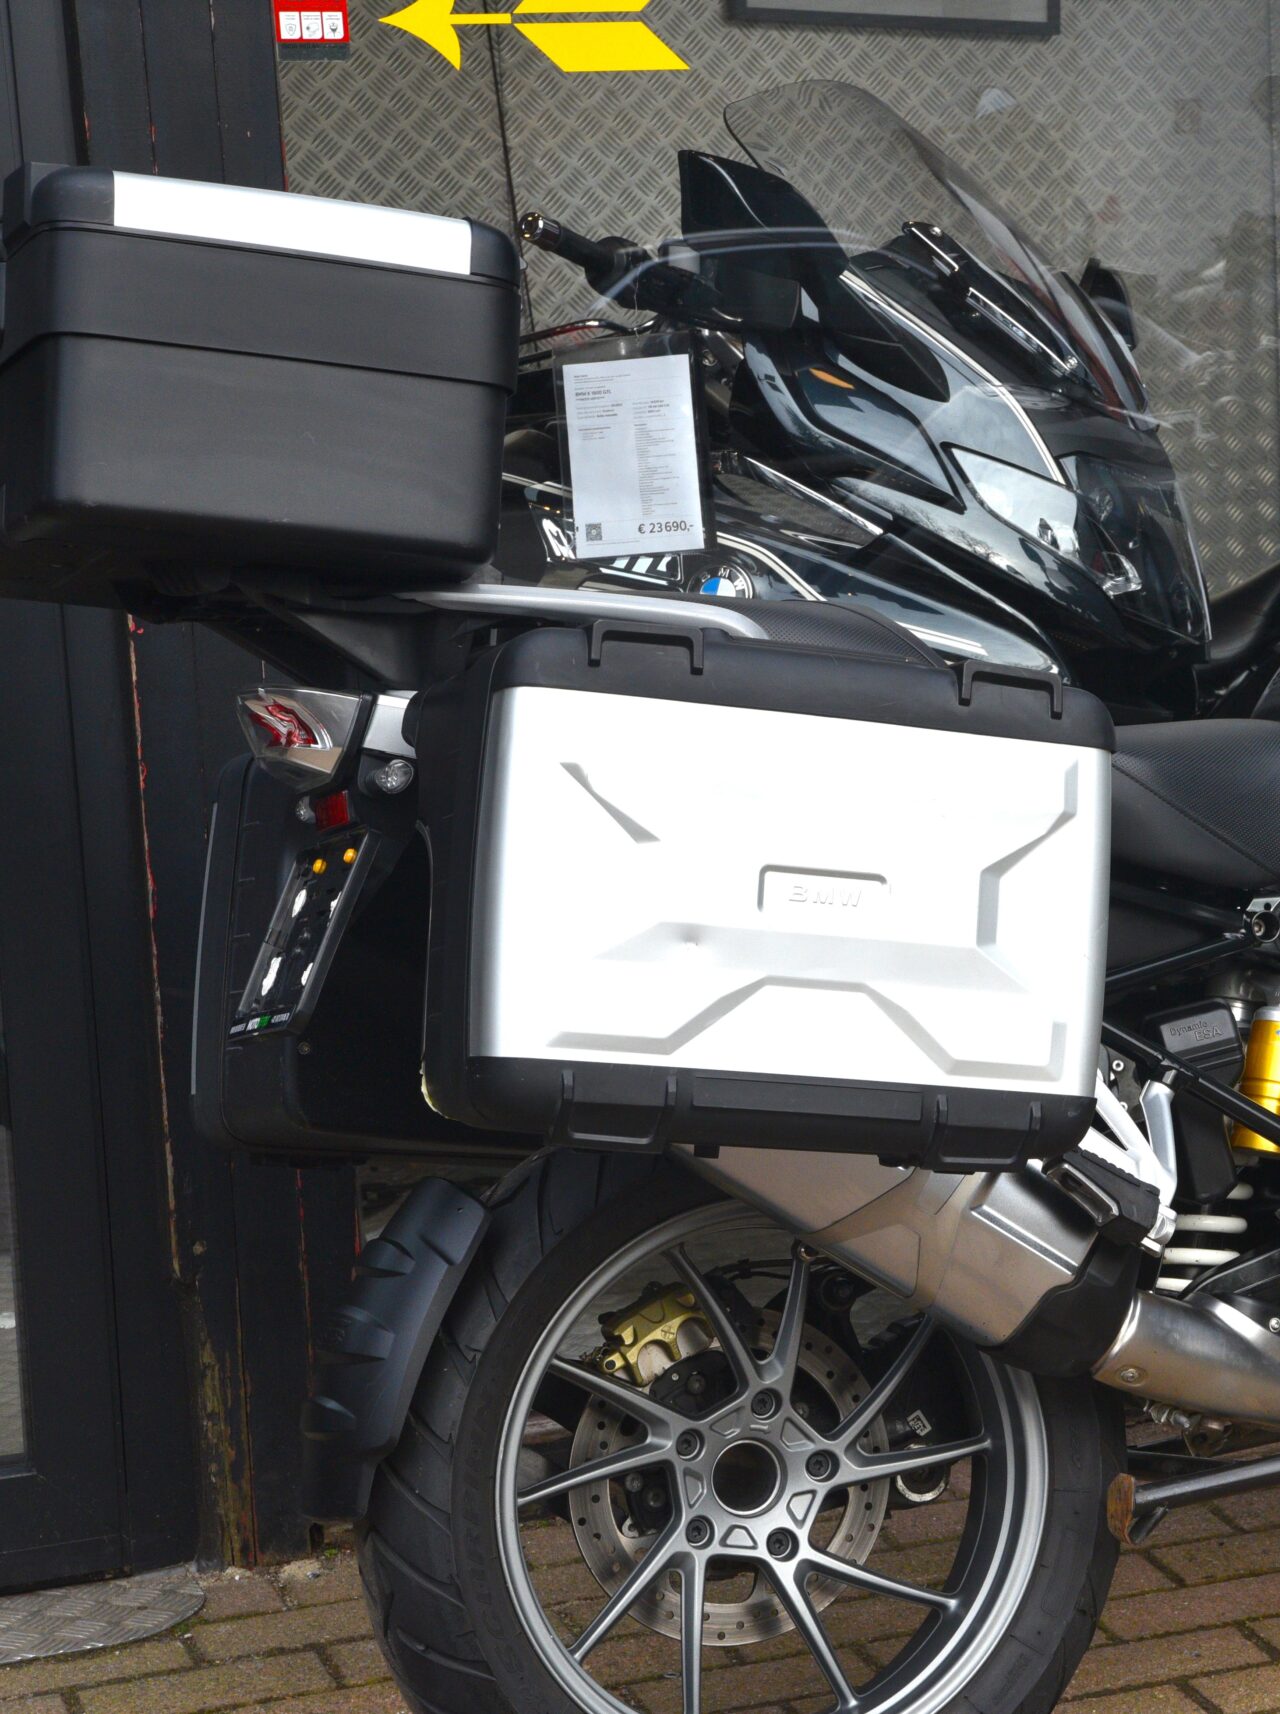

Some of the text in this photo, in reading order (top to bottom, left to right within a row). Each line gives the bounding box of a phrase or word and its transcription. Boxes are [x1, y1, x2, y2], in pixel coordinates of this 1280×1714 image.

[637, 523, 646, 534] €
[702, 567, 746, 592] BMW
[788, 885, 862, 908] BMW
[1169, 1020, 1208, 1037] Dynamic
[1194, 1025, 1225, 1042] ESA
